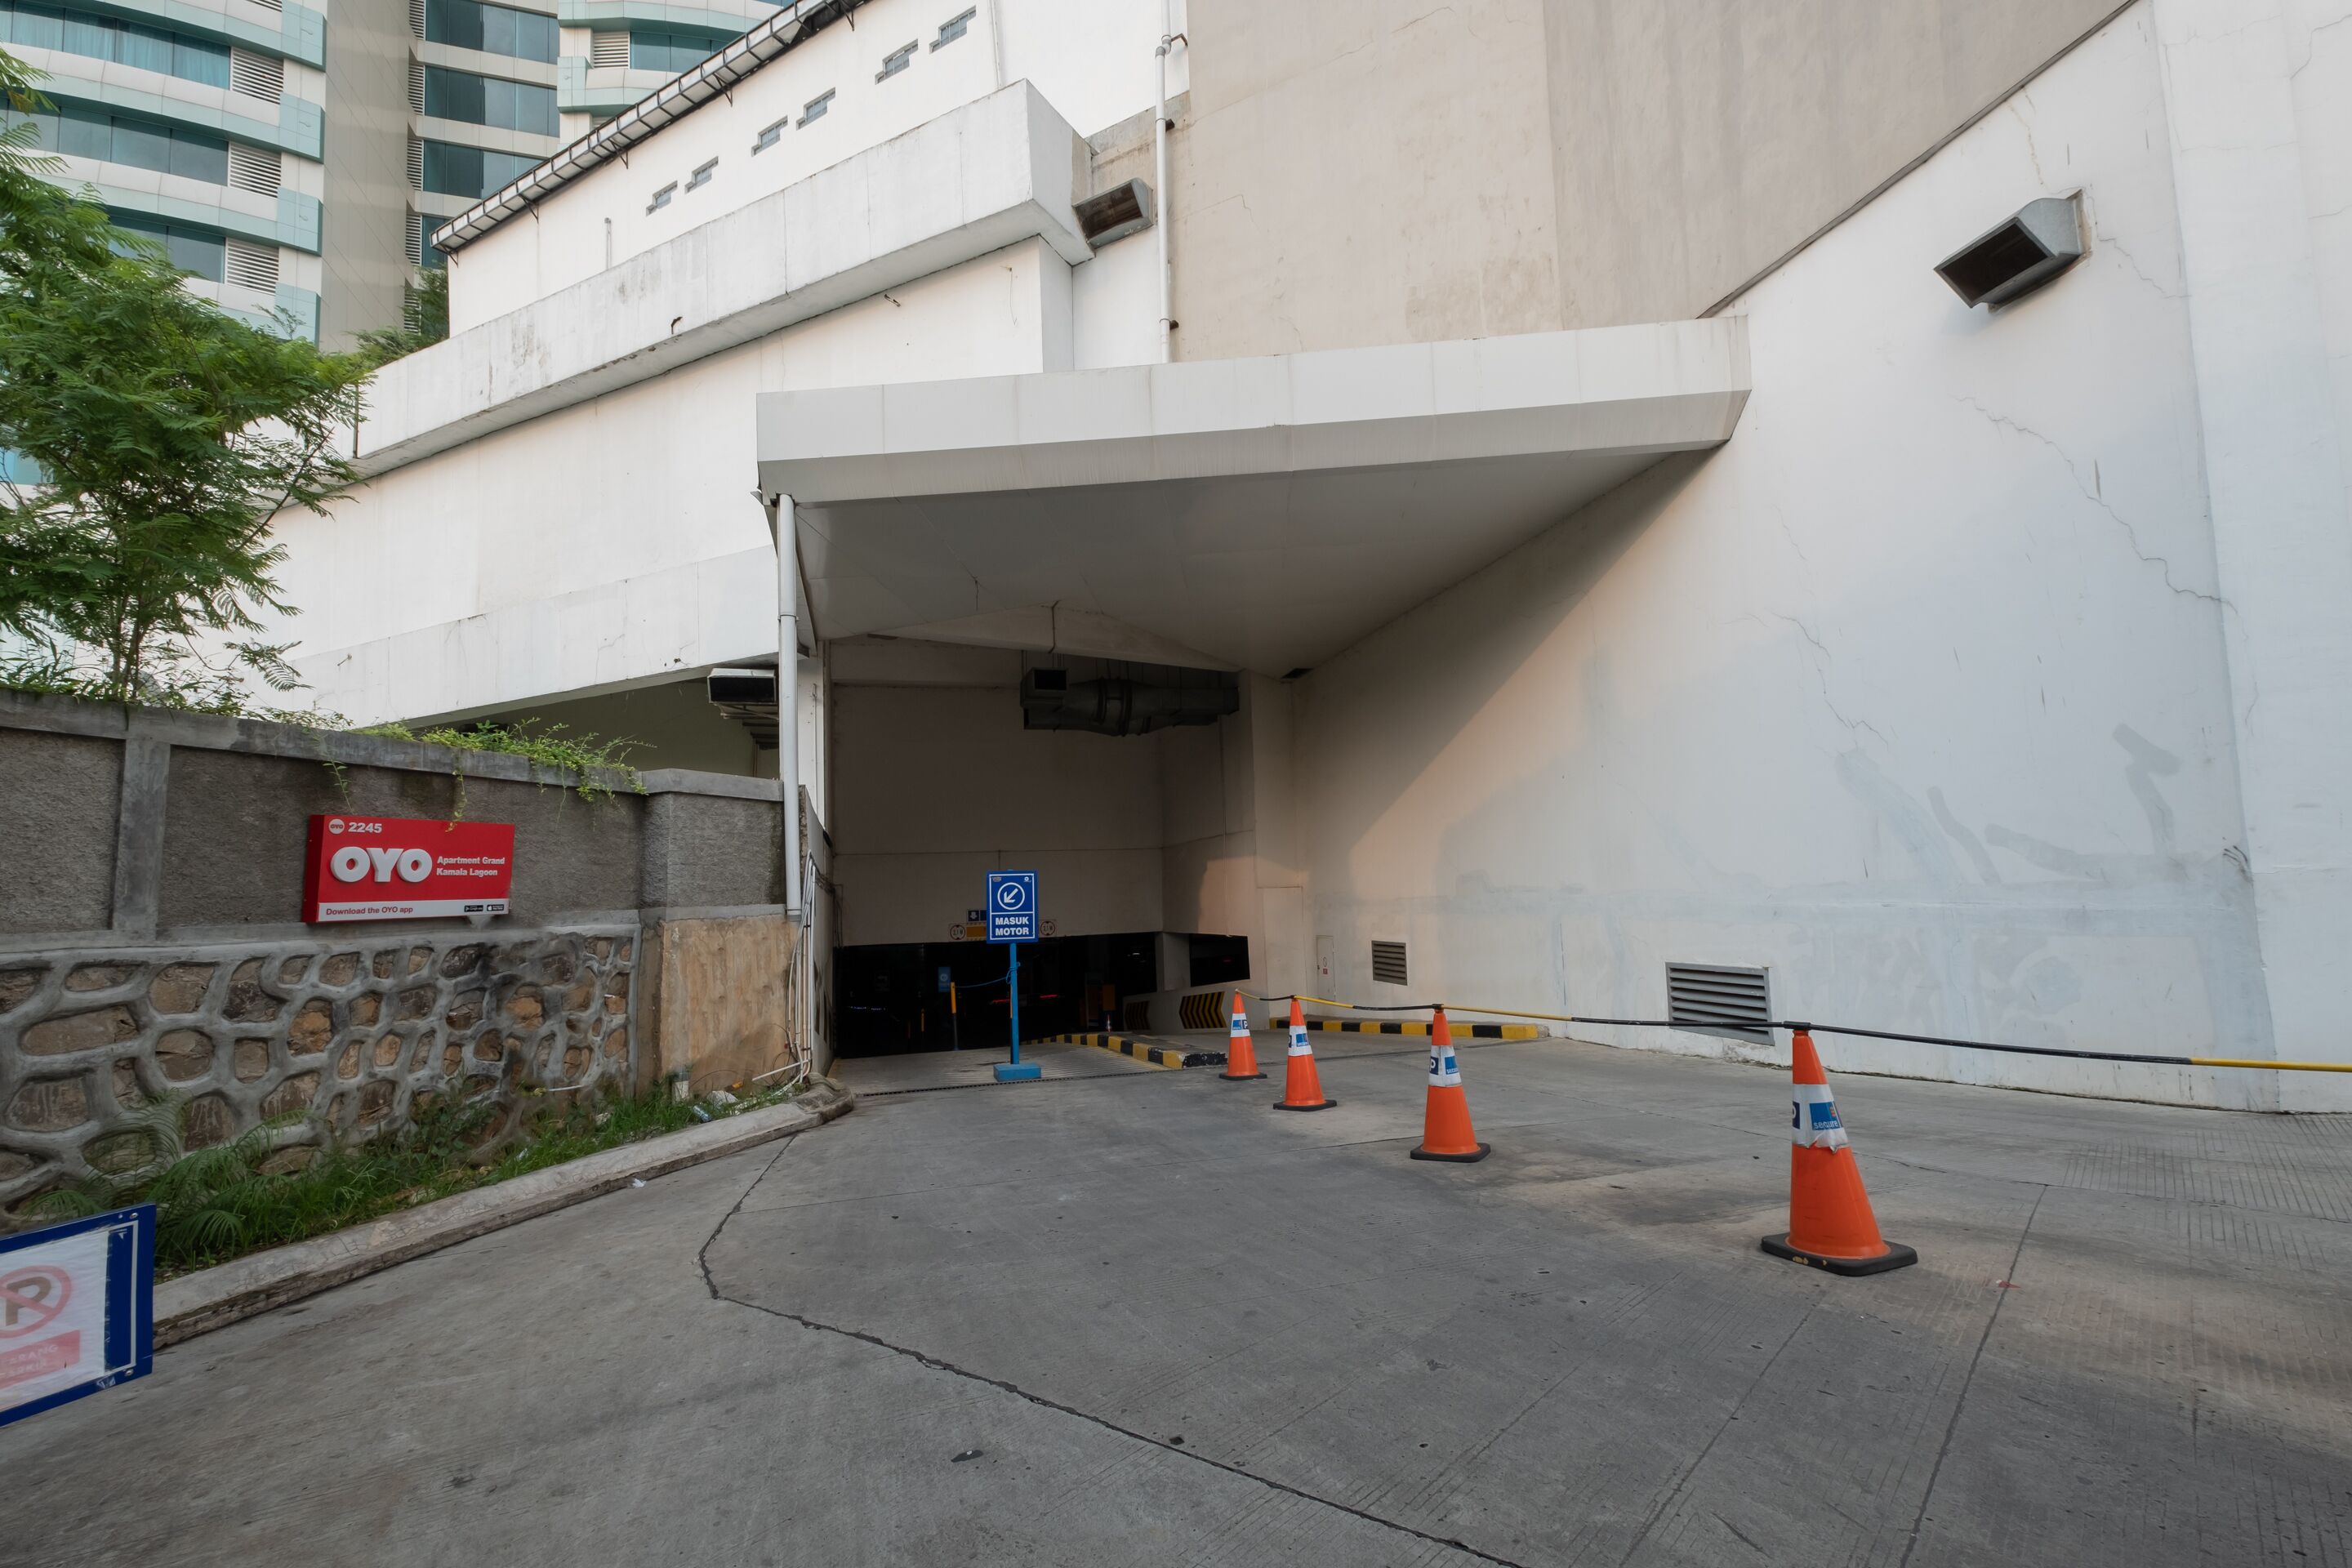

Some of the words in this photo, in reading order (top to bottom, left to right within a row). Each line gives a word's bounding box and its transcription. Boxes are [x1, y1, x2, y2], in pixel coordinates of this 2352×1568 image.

[348, 822, 382, 833] 2245
[330, 846, 433, 882] OYO
[437, 855, 480, 866] Apartment
[482, 857, 506, 865] Grand
[436, 868, 468, 876] Kamala
[470, 868, 497, 878] Lagoon
[995, 916, 1029, 925] MASUK
[995, 927, 1029, 936] MOTOR
